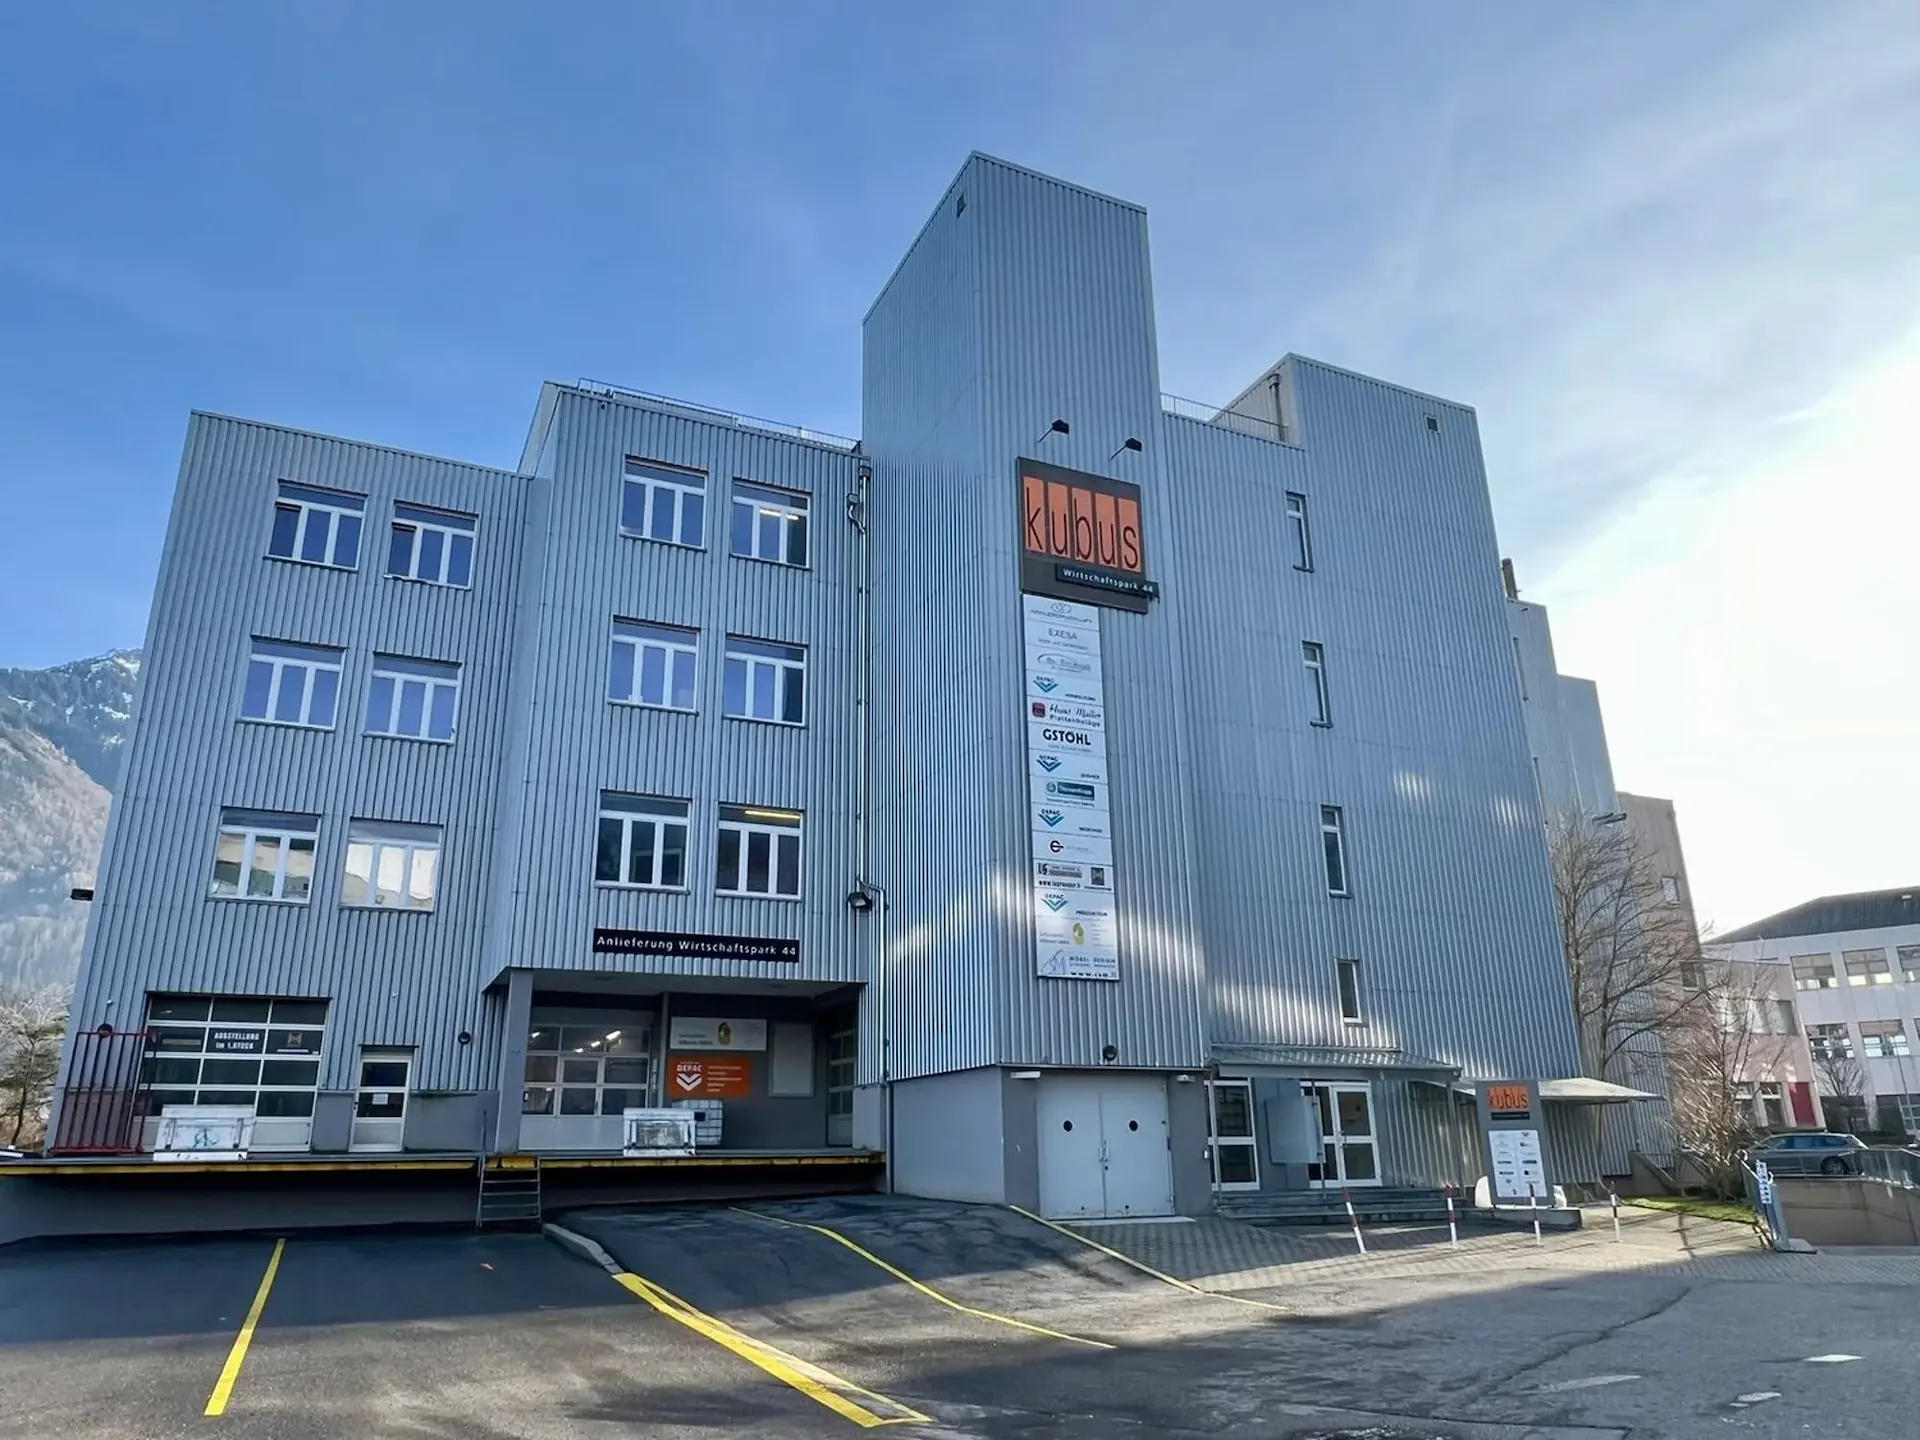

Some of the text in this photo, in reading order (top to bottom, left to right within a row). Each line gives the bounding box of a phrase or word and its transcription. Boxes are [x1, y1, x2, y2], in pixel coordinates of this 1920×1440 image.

[1026, 486, 1138, 569] kubus
[1062, 567, 1154, 593] Wirtschaftspark 44
[596, 935, 796, 956] Anlieferung Wirtschaftspark 44
